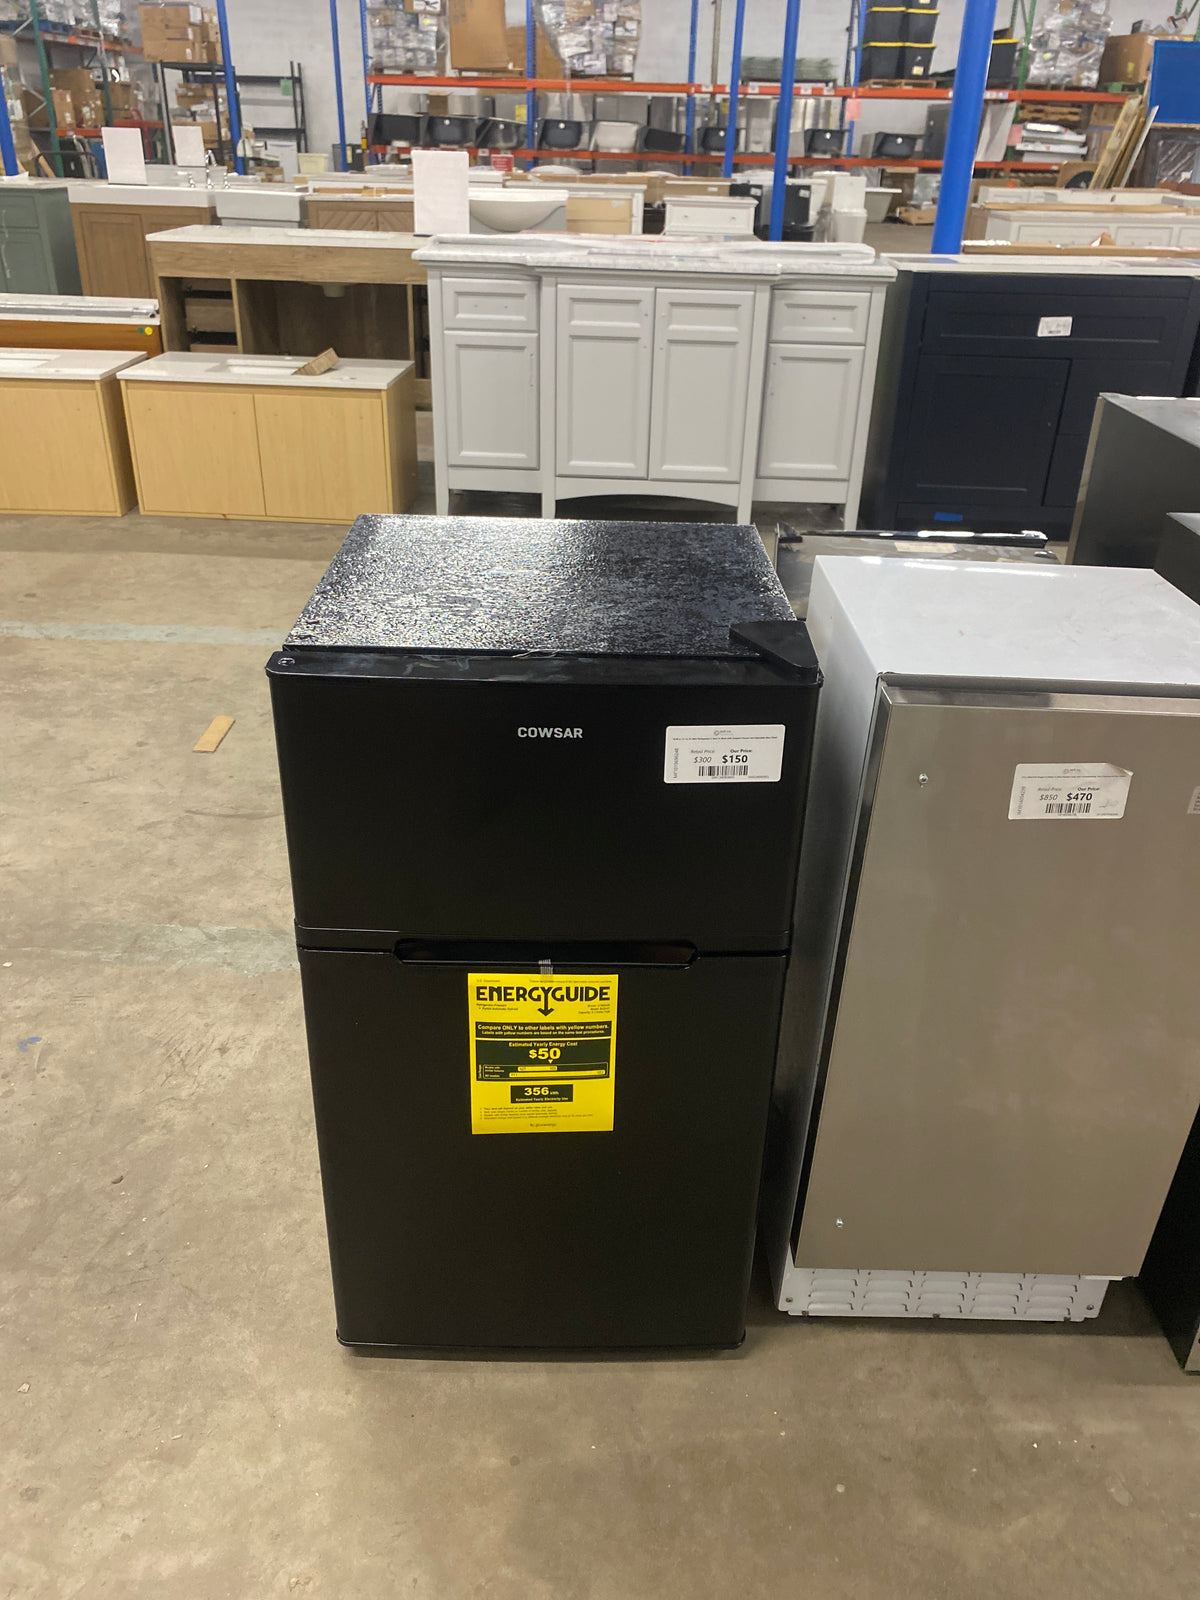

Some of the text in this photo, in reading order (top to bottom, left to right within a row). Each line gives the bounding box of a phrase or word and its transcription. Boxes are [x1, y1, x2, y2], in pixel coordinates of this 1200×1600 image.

[517, 726, 583, 739] COWSAR
[693, 756, 713, 764] $300
[721, 754, 748, 764] $150
[1038, 793, 1058, 801] $850
[1066, 792, 1093, 801] $470
[476, 986, 610, 1002] ENERGYGUIDE
[528, 1047, 561, 1060] $50
[524, 1086, 549, 1096] 356
